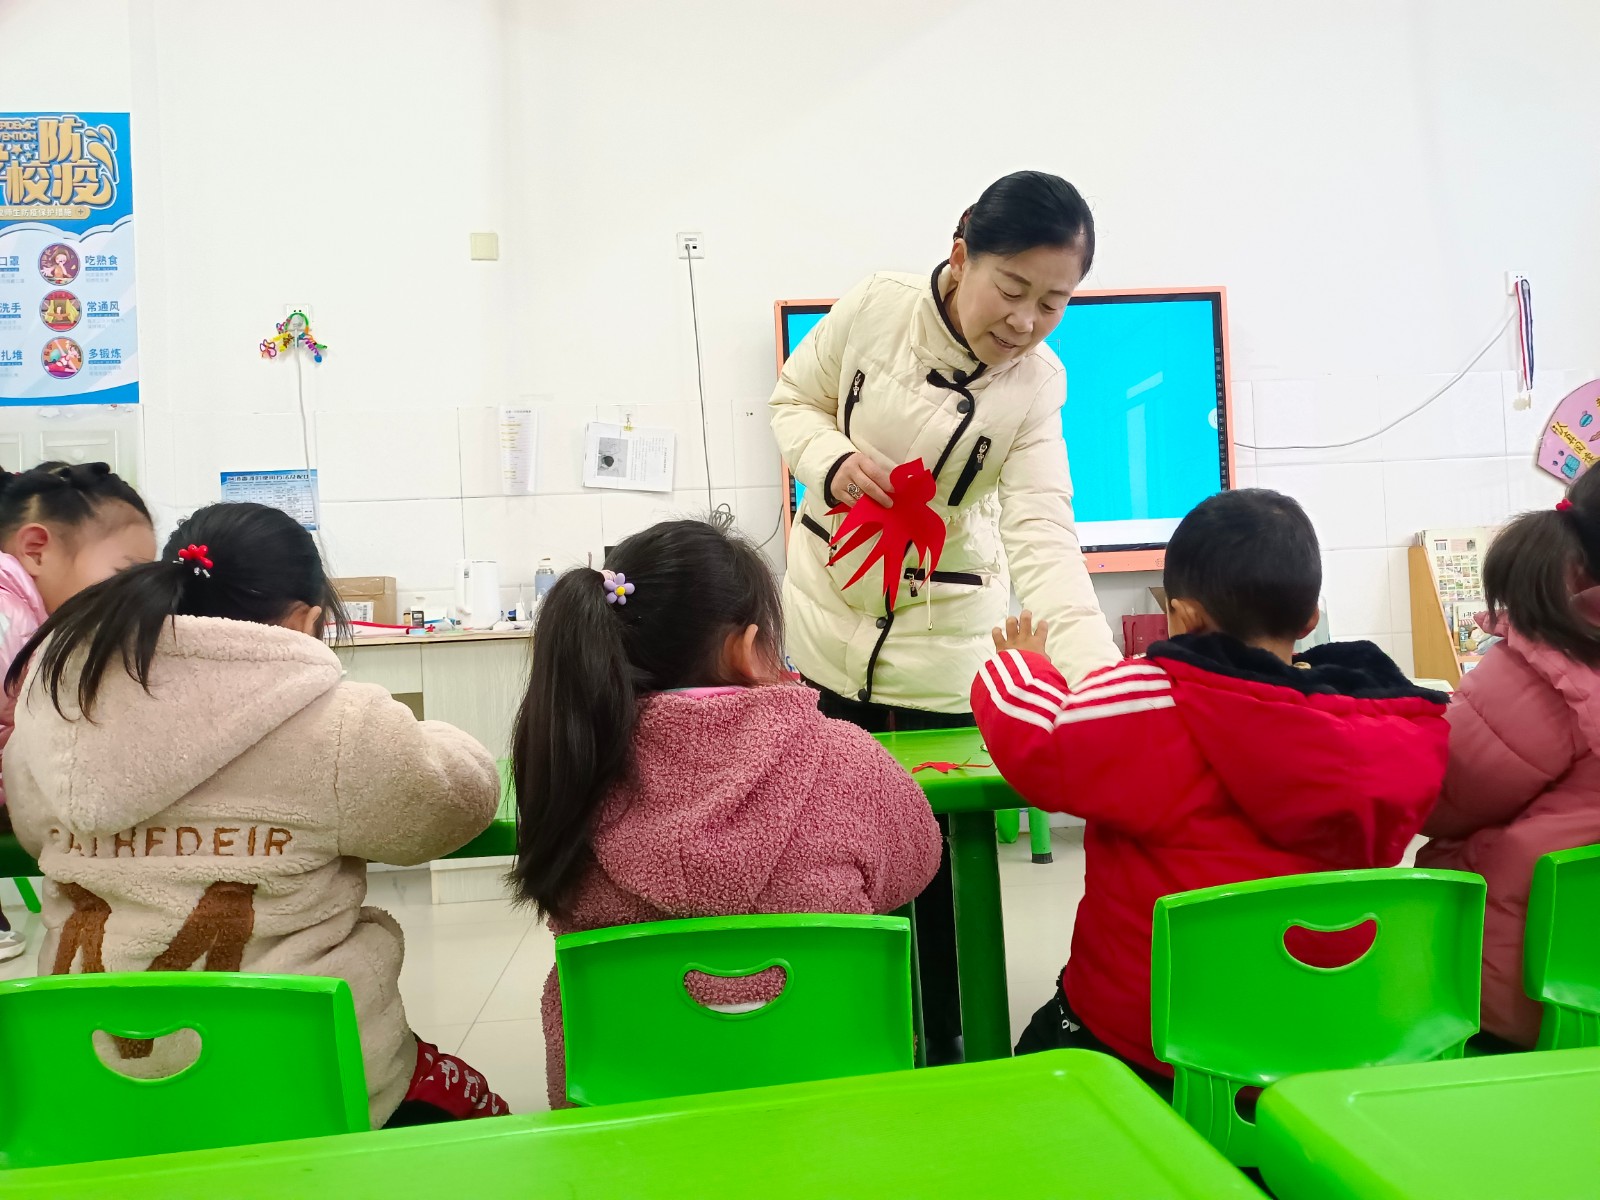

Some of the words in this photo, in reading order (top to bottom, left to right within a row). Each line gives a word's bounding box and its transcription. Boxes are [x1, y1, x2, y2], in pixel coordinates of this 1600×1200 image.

[38, 117, 82, 163] 防
[0, 159, 112, 205] 校疫
[85, 254, 118, 266] 吃熟食
[0, 302, 22, 313] 洗手
[86, 300, 120, 312] 常通风
[0, 349, 23, 361] 扎堆
[88, 348, 121, 359] 多锻炼
